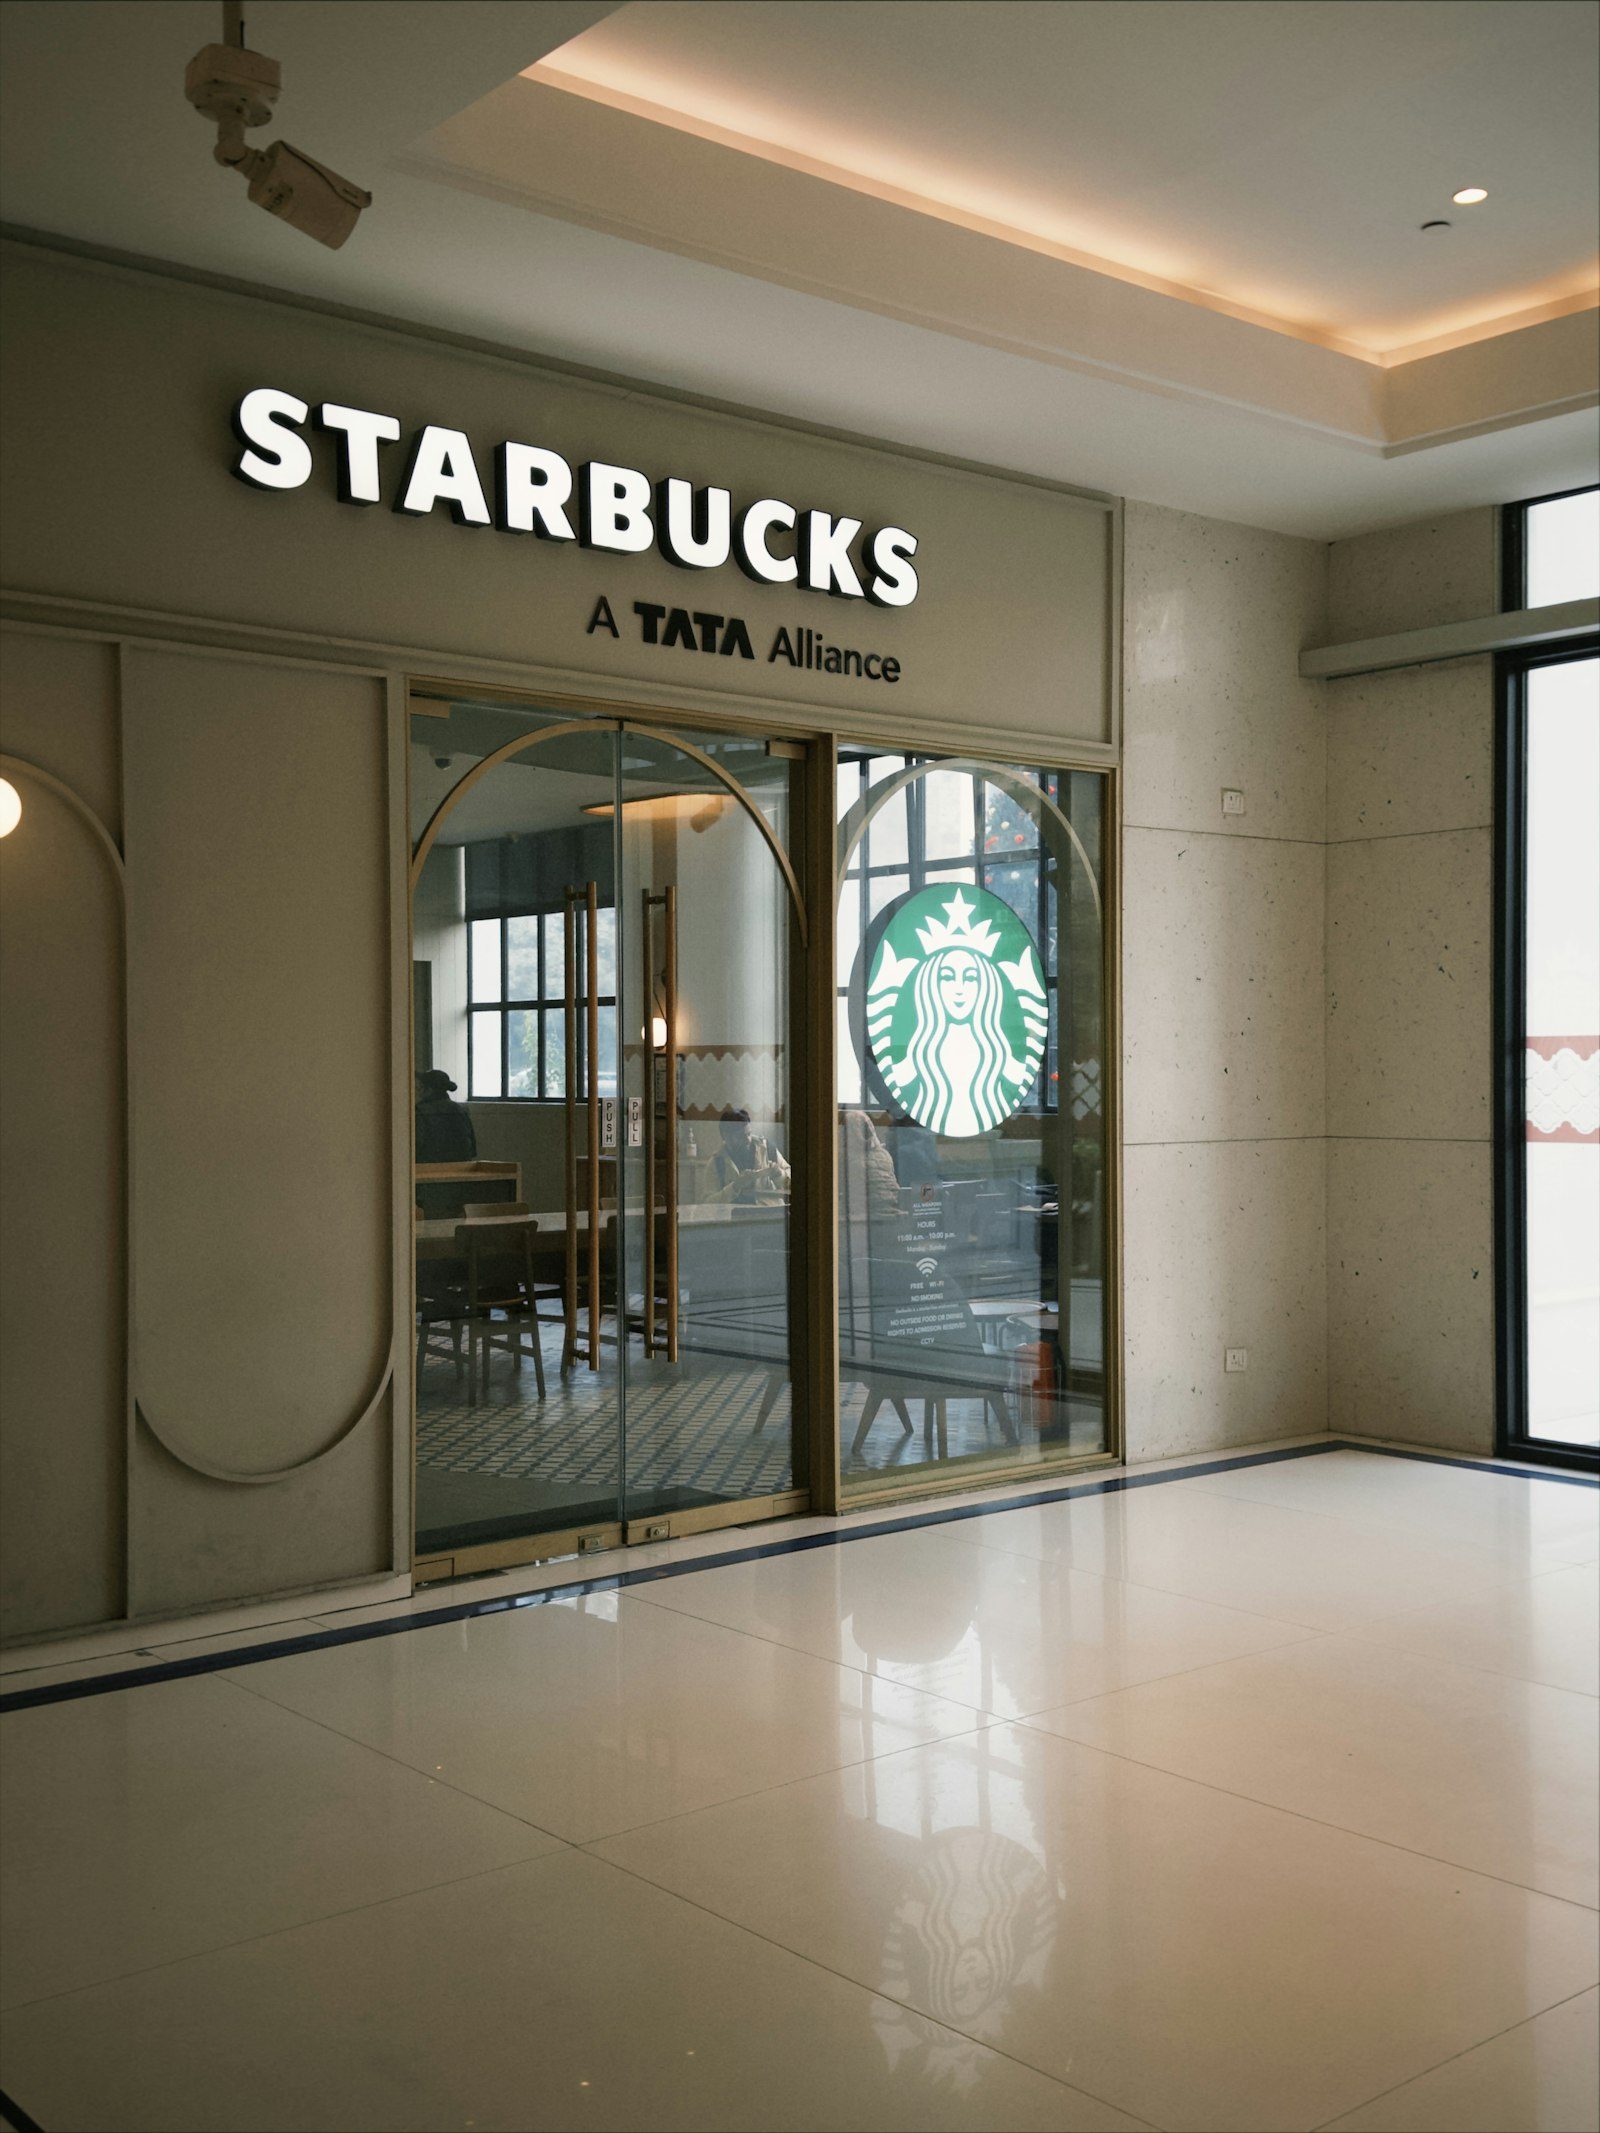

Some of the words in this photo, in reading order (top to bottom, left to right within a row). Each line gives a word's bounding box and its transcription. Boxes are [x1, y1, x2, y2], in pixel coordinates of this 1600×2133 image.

[237, 387, 919, 607] STARBUCKS
[586, 595, 620, 638] A
[633, 601, 755, 660] TATA
[768, 626, 902, 683] Alliance
[917, 1220, 936, 1228] HOURS
[920, 1293, 943, 1301] SMOKING
[900, 1317, 921, 1325] OUTSIDE
[922, 1315, 937, 1323] FOOD
[920, 1337, 935, 1345] CCTV
